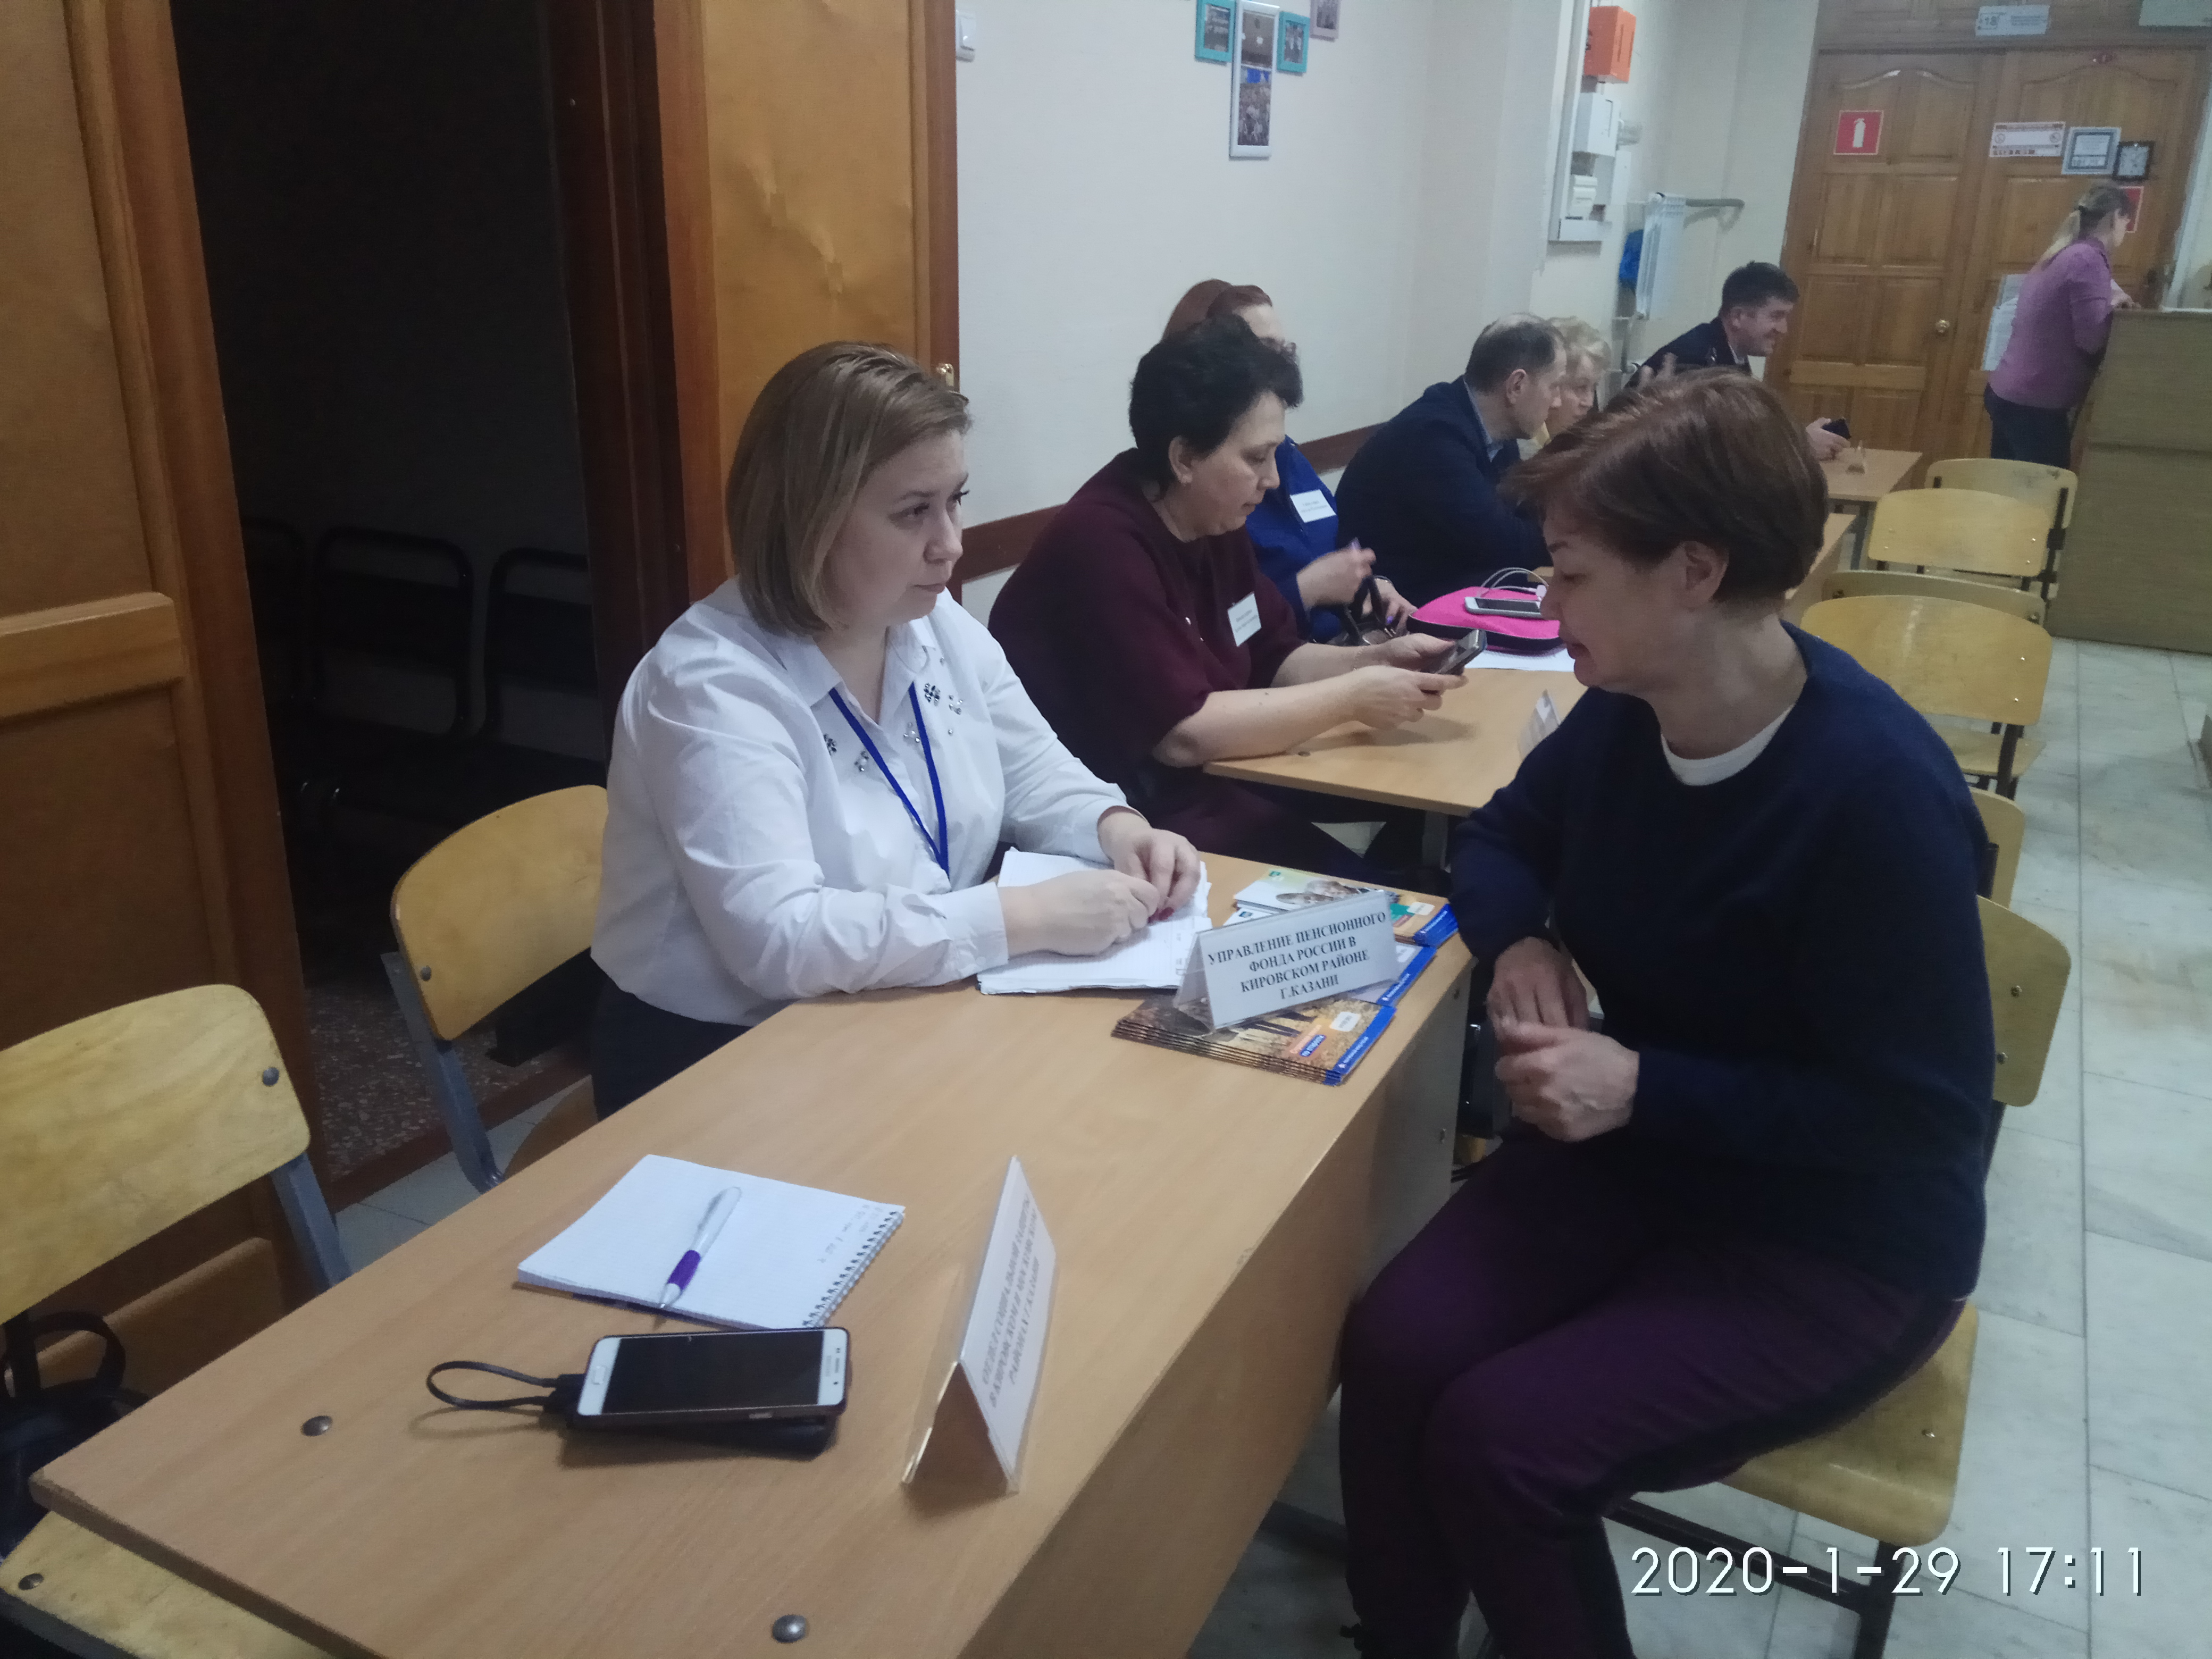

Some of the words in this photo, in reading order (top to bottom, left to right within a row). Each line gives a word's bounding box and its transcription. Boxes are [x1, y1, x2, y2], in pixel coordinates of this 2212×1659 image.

[1208, 934, 1294, 965] УПРАВЛЕНИЕ
[1295, 911, 1386, 944] ПЕНСИОННОГО
[1249, 953, 1295, 972] ФОНДА
[1297, 940, 1346, 960] РОССИИ
[1348, 936, 1357, 948] В
[1240, 963, 1320, 993] КИРОВСКОМ
[1322, 949, 1370, 972] РАЙОНЕ
[1280, 974, 1339, 1000] Г.КАЗАНИ
